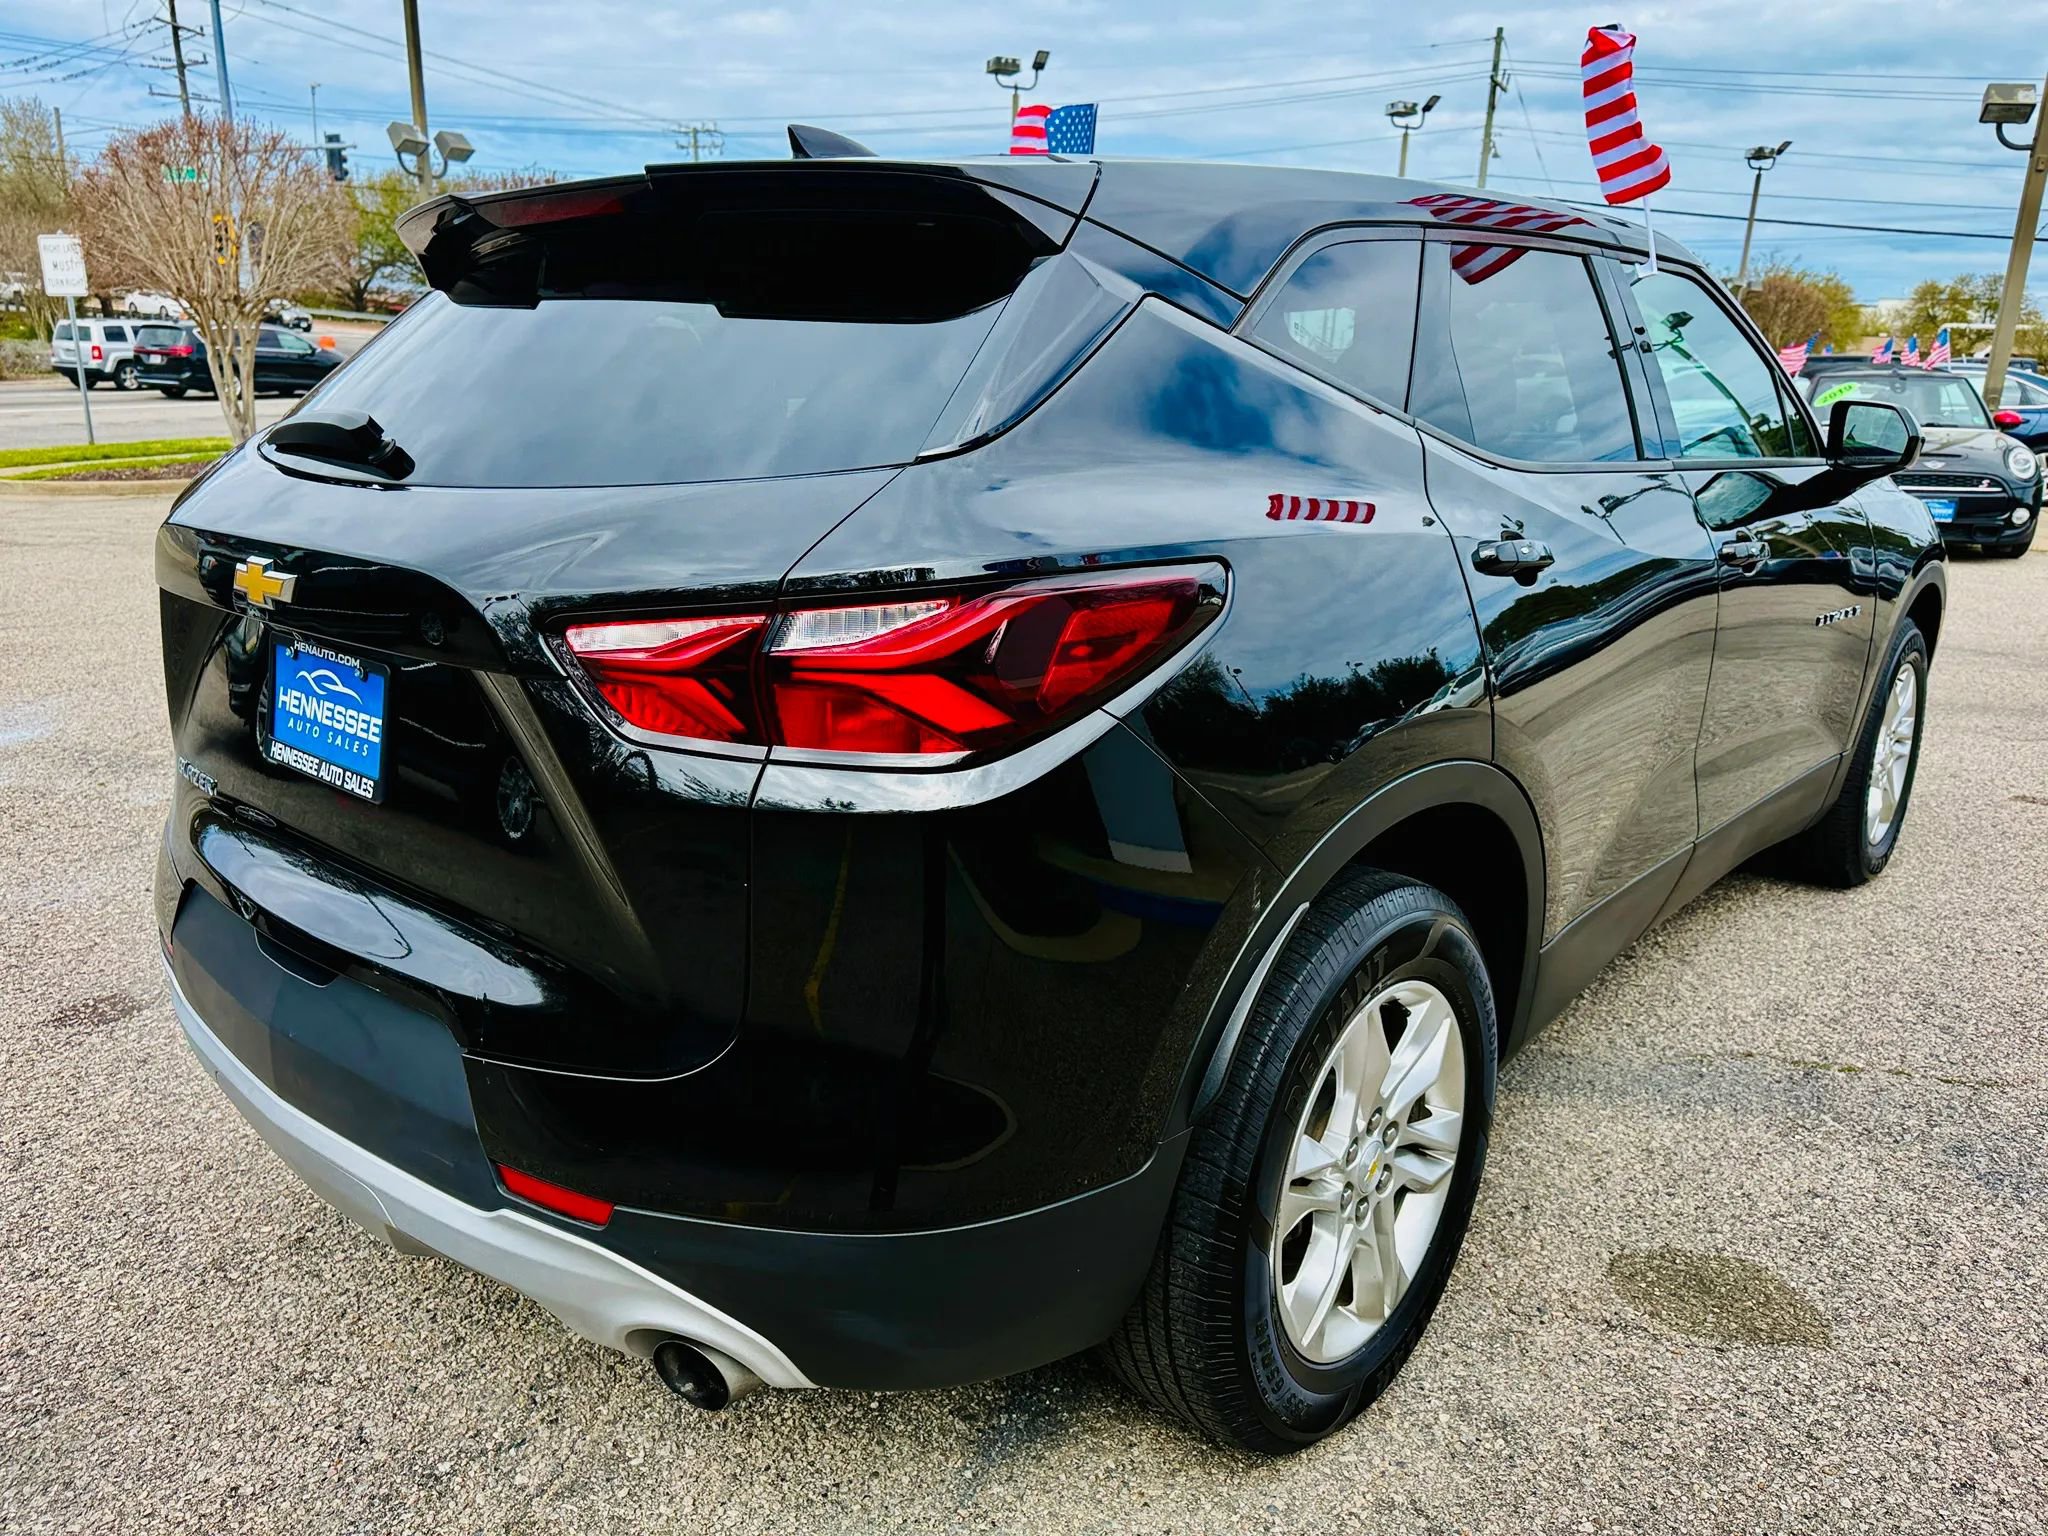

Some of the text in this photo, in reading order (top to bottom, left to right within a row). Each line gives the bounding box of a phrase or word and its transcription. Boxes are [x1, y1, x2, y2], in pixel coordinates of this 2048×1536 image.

[1822, 384, 1852, 403] 2019
[294, 641, 360, 668] HENAUTO.COM
[278, 686, 382, 743] HENNESSEE
[288, 717, 369, 757] AUTO SALES
[270, 740, 374, 799] HENNESSEE AUTO SALES
